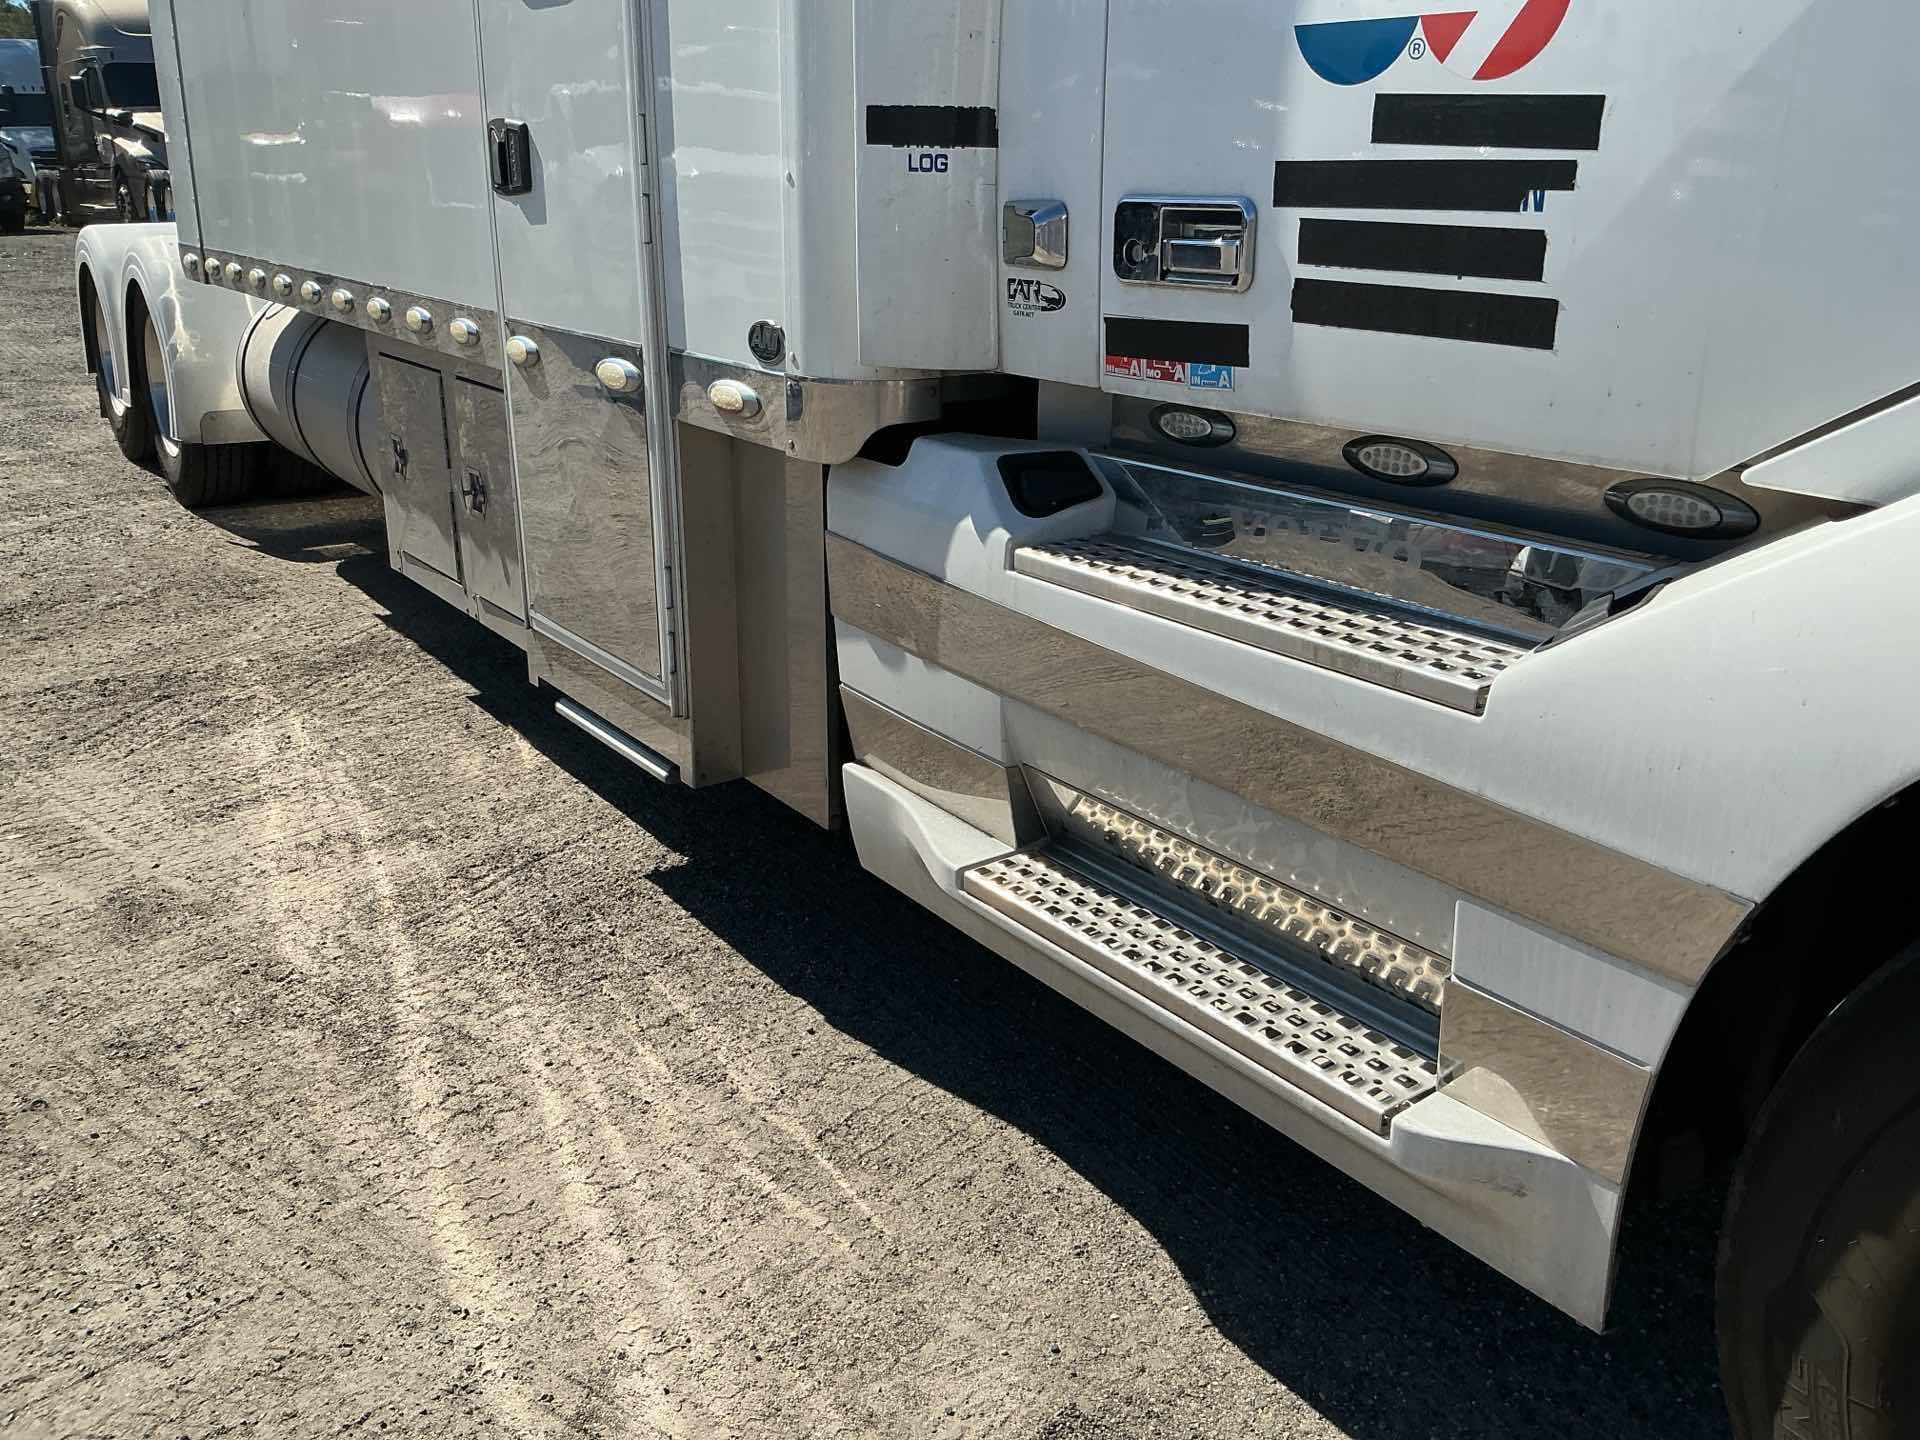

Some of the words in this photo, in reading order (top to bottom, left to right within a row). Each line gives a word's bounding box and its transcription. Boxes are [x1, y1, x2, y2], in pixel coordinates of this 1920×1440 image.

[908, 153, 949, 172] LOG
[1130, 360, 1141, 377] A
[1147, 368, 1162, 379] MO
[1174, 364, 1186, 382] A
[1192, 375, 1202, 385] IN
[1218, 370, 1230, 387] A
